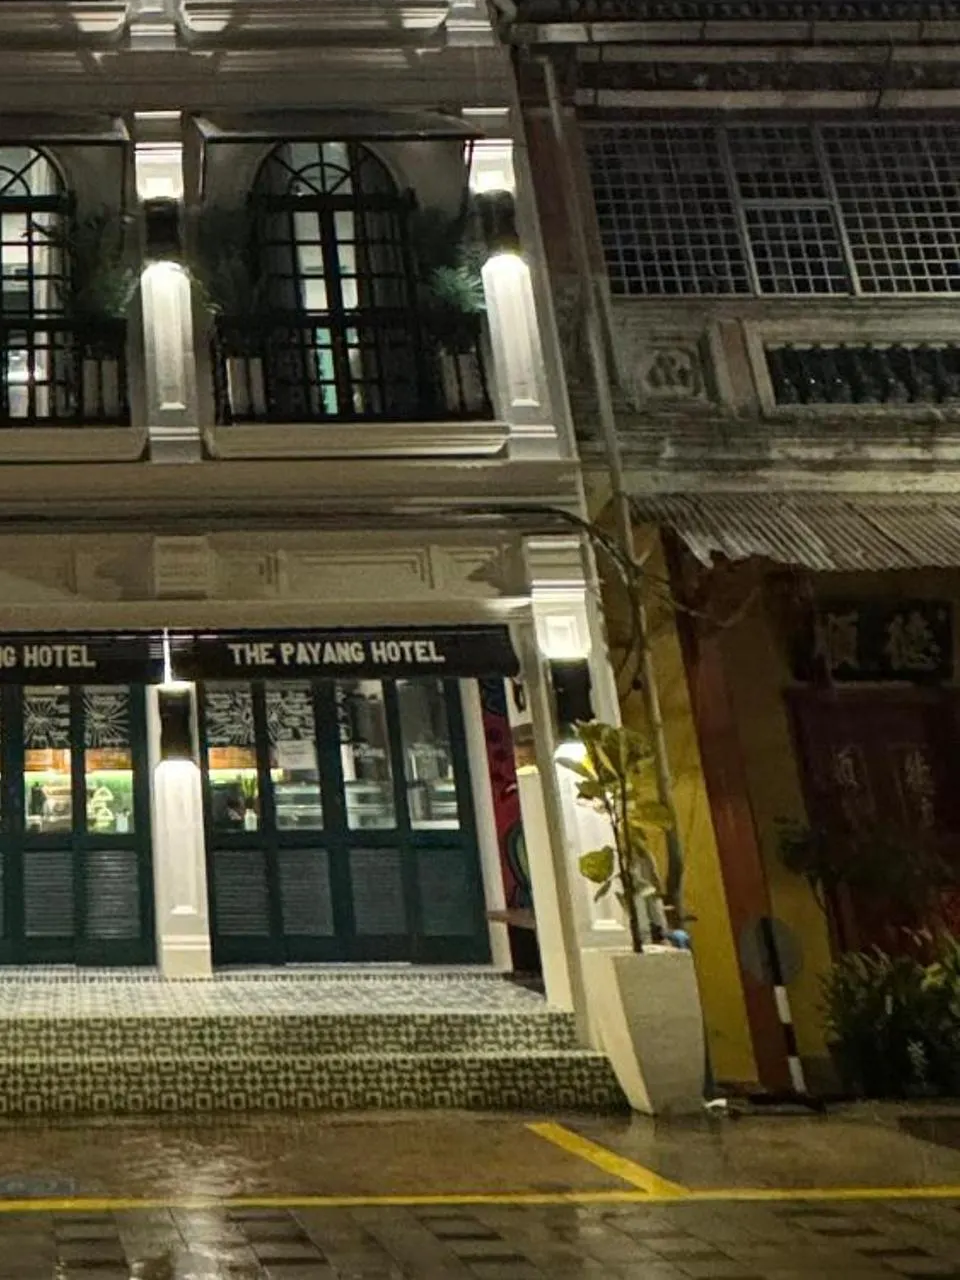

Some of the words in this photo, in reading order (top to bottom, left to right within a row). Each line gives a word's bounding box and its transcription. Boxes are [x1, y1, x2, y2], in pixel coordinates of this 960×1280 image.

[23, 644, 97, 668] HOTEL
[227, 642, 276, 666] THE
[280, 641, 365, 665] PAYANG
[370, 639, 446, 663] HOTEL
